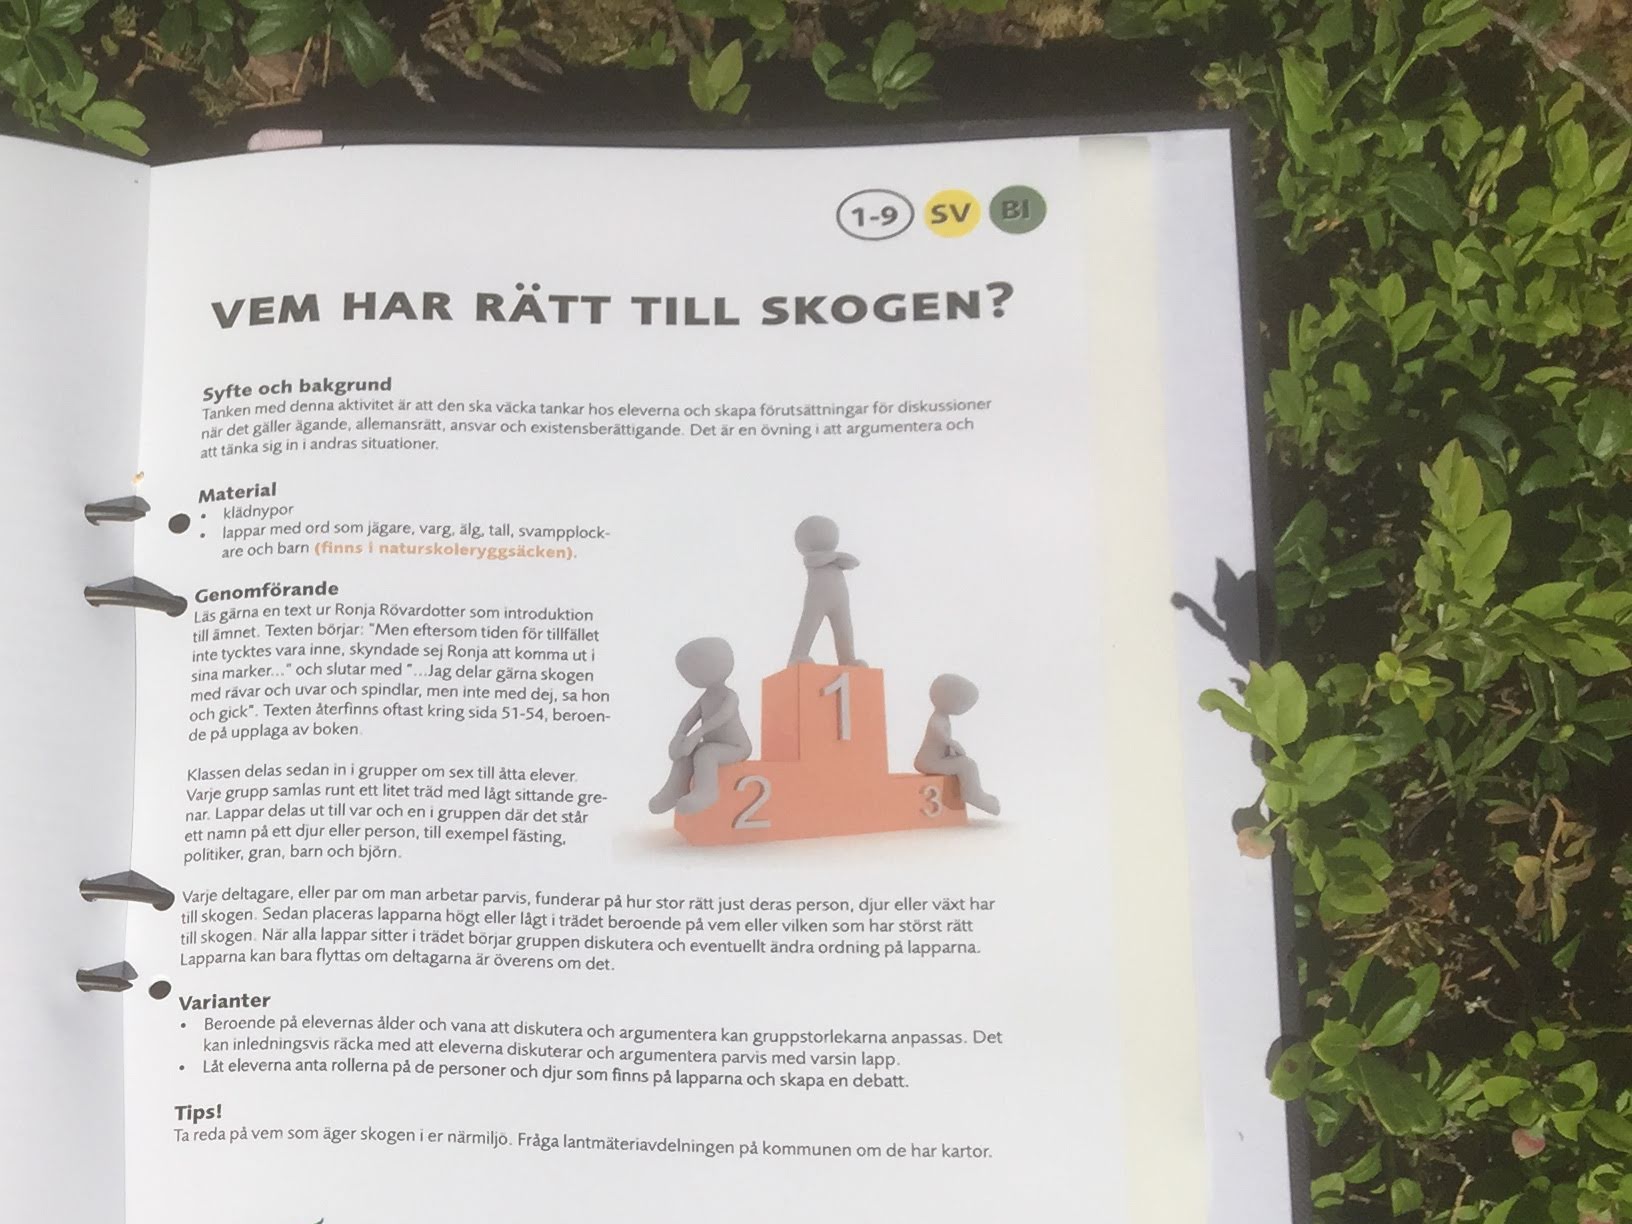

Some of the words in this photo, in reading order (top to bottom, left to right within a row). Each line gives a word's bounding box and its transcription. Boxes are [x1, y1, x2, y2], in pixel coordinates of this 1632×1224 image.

[851, 205, 899, 227] 1-9
[930, 202, 972, 225] SV
[1001, 198, 1030, 220] BI
[210, 293, 321, 330] VEM
[342, 291, 454, 321] HAR
[475, 282, 612, 325] RÄTT
[630, 296, 741, 326] TILL
[761, 281, 1014, 326] SKOGEN?
[202, 382, 253, 406] Syfte
[257, 378, 293, 396] och
[298, 376, 392, 397] bakgrund
[201, 404, 252, 421] Tanken
[254, 399, 287, 415] med
[289, 399, 335, 414] denna
[337, 397, 395, 412] aktivitet
[397, 398, 412, 412] är
[414, 399, 434, 412] att
[436, 398, 465, 412] den
[468, 399, 493, 414] ska
[495, 400, 537, 415] väcka
[539, 401, 586, 416] tankar
[588, 402, 615, 417] hos
[617, 402, 681, 417] eleverna
[683, 403, 711, 418] och
[714, 403, 757, 421] skapa
[759, 402, 870, 420] förutsättningar
[872, 400, 895, 415] för
[897, 398, 992, 414] diskussioner
[197, 480, 277, 505] Material
[223, 503, 295, 521] klädnypor
[222, 525, 268, 543] lappar
[269, 520, 302, 536] med
[304, 520, 330, 535] ord
[333, 523, 364, 535] som
[366, 520, 416, 538] jägare,
[418, 524, 456, 540] varg,
[458, 522, 486, 540] älg,
[488, 522, 515, 539] tall,
[518, 524, 611, 543] svampplock-
[221, 546, 244, 559] are
[246, 541, 274, 557] och
[276, 540, 310, 555] barn
[314, 540, 364, 557] (finns
[368, 540, 374, 554] i
[378, 542, 577, 561] naturskoleryggsäcken).
[194, 580, 340, 604] Genomförande
[194, 609, 217, 624] Läs
[218, 606, 260, 625] gärna
[262, 606, 281, 618] en
[284, 603, 313, 617] text
[315, 605, 332, 617] ur
[334, 602, 376, 620] Ronja
[379, 602, 467, 618] Rövardotter
[469, 608, 500, 620] som
[503, 606, 594, 622] introduktion
[192, 628, 210, 644] till
[212, 625, 261, 642] ämnet.
[264, 623, 314, 638] Texten
[316, 621, 364, 640] börjar:
[412, 622, 478, 639] eftersom
[480, 624, 519, 640] tiden
[521, 625, 544, 641] för
[546, 626, 600, 643] tillfället
[818, 671, 852, 741] 1
[731, 775, 772, 830] 2
[919, 785, 944, 818] 3
[183, 845, 244, 867] politiker,
[247, 847, 286, 864] gran,
[290, 843, 324, 858] barn
[326, 842, 355, 858] och
[358, 843, 402, 863] björn.
[180, 952, 247, 969] Lapparna
[250, 948, 276, 963] kan
[280, 946, 314, 962] bara
[315, 946, 362, 966] flyttas
[364, 951, 389, 963] om
[392, 948, 472, 969] deltagarna
[474, 952, 491, 966] är
[493, 952, 554, 969] överens
[556, 958, 582, 970] om
[584, 955, 616, 972] det.
[178, 992, 272, 1012] Varianter
[204, 1014, 276, 1032] Beroende
[279, 1014, 298, 1033] på
[301, 1014, 374, 1030] elevernas
[376, 1014, 416, 1031] ålder
[418, 1016, 448, 1032] och
[450, 1020, 488, 1034] vana
[490, 1020, 510, 1035] att
[512, 1020, 584, 1038] diskutera
[586, 1023, 616, 1039] och
[618, 1028, 718, 1044] argumentera
[720, 1026, 749, 1043] kan
[752, 1028, 889, 1048] gruppstorlekarna
[890, 1032, 968, 1049] anpassas.
[972, 1029, 1004, 1045] Det
[173, 1103, 222, 1126] Tips!
[172, 1128, 190, 1143] Ta
[192, 1125, 227, 1142] reda
[229, 1125, 249, 1145] på
[250, 1128, 284, 1140] vem
[286, 1128, 319, 1140] som
[322, 1126, 358, 1145] äger
[360, 1125, 416, 1146] skogen
[419, 1128, 424, 1143] i
[426, 1131, 444, 1143] er
[447, 1130, 513, 1150] närmiljö.
[517, 1132, 560, 1152] Fråga
[562, 1133, 735, 1159] lantmäteriavdelningen
[738, 1140, 760, 1159] på
[762, 1139, 852, 1157] kommunen
[855, 1146, 882, 1158] om
[885, 1142, 907, 1158] de
[910, 1142, 938, 1158] har
[941, 1142, 993, 1159] kartor.
